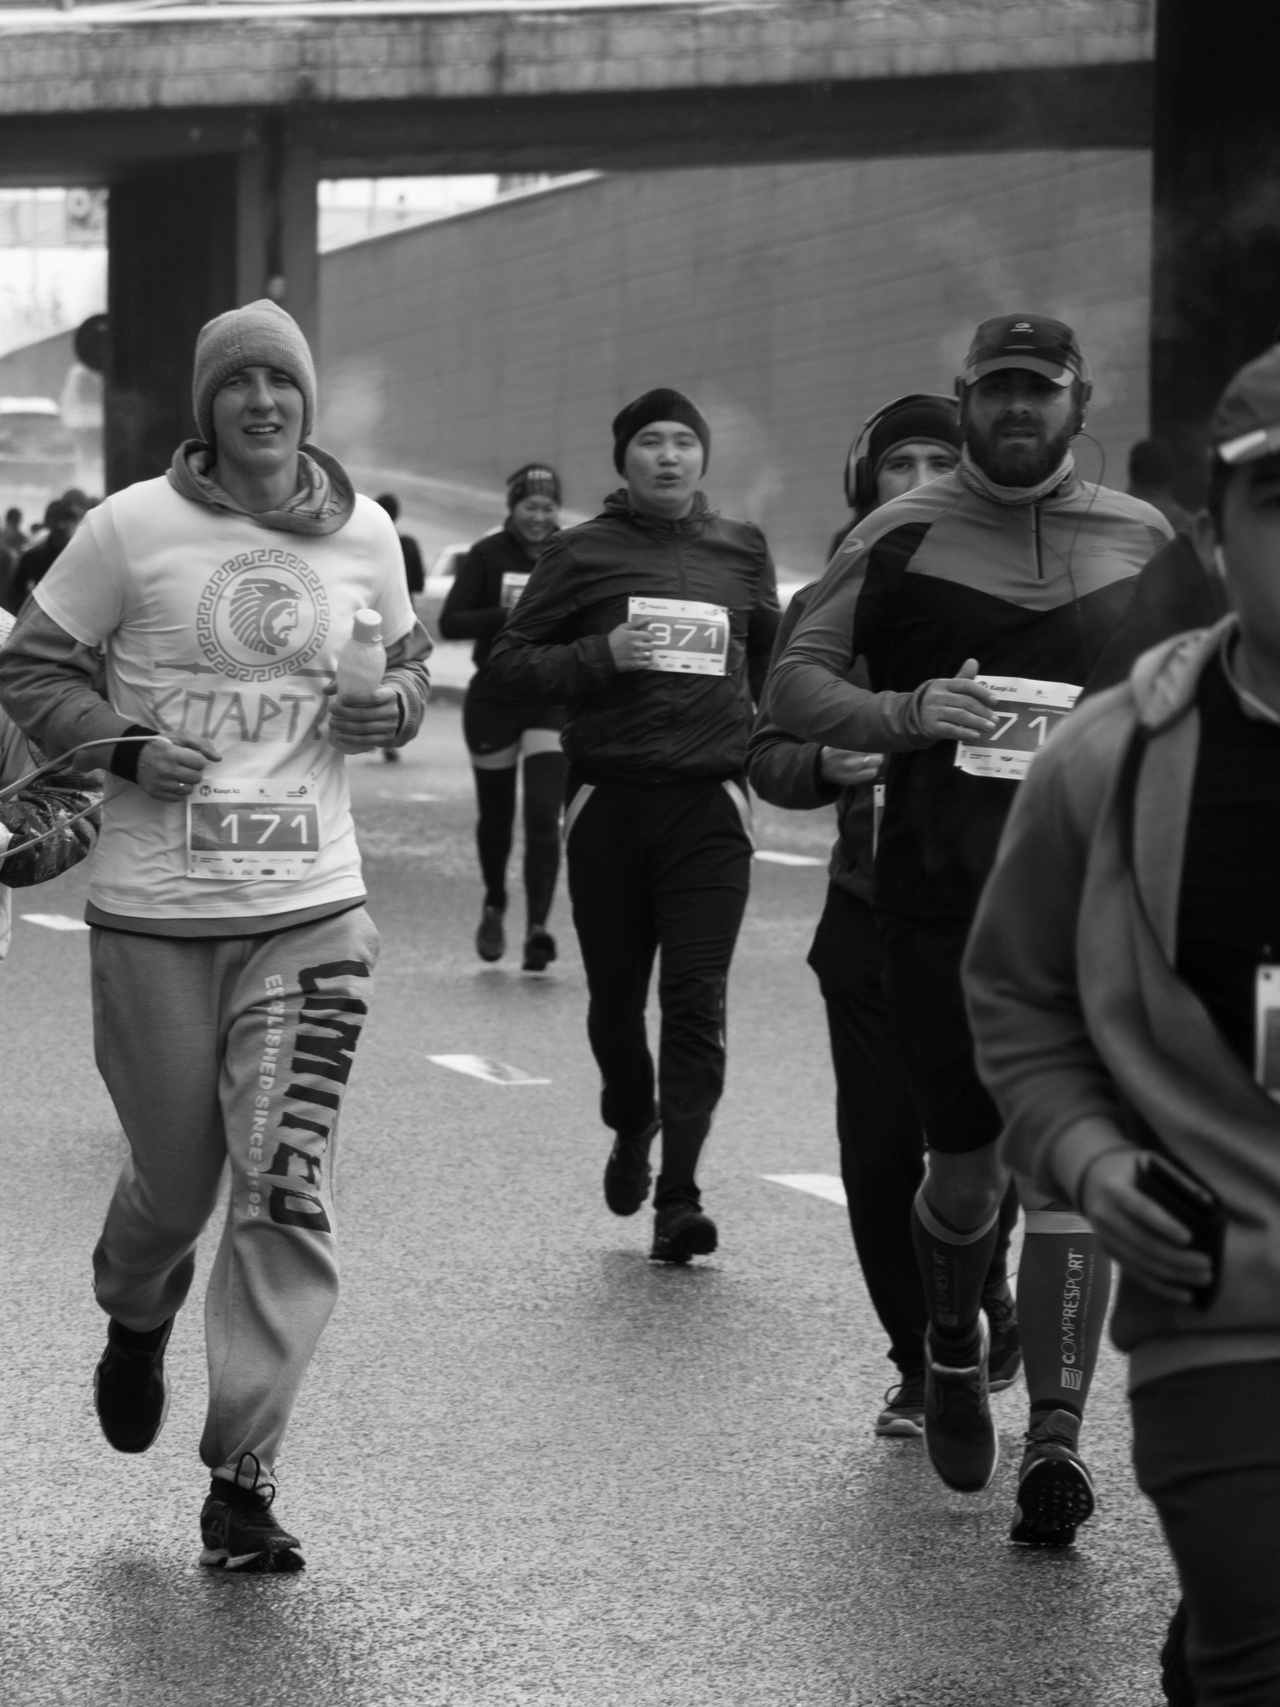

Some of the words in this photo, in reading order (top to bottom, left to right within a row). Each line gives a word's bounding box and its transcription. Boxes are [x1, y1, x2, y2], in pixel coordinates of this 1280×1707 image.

[648, 623, 718, 649] 371
[153, 688, 329, 742] СПАРТ
[220, 814, 308, 844] 171
[260, 974, 285, 1090] ESABLISHED
[268, 960, 370, 1234] LIMITED
[247, 1095, 270, 1161] SINCE
